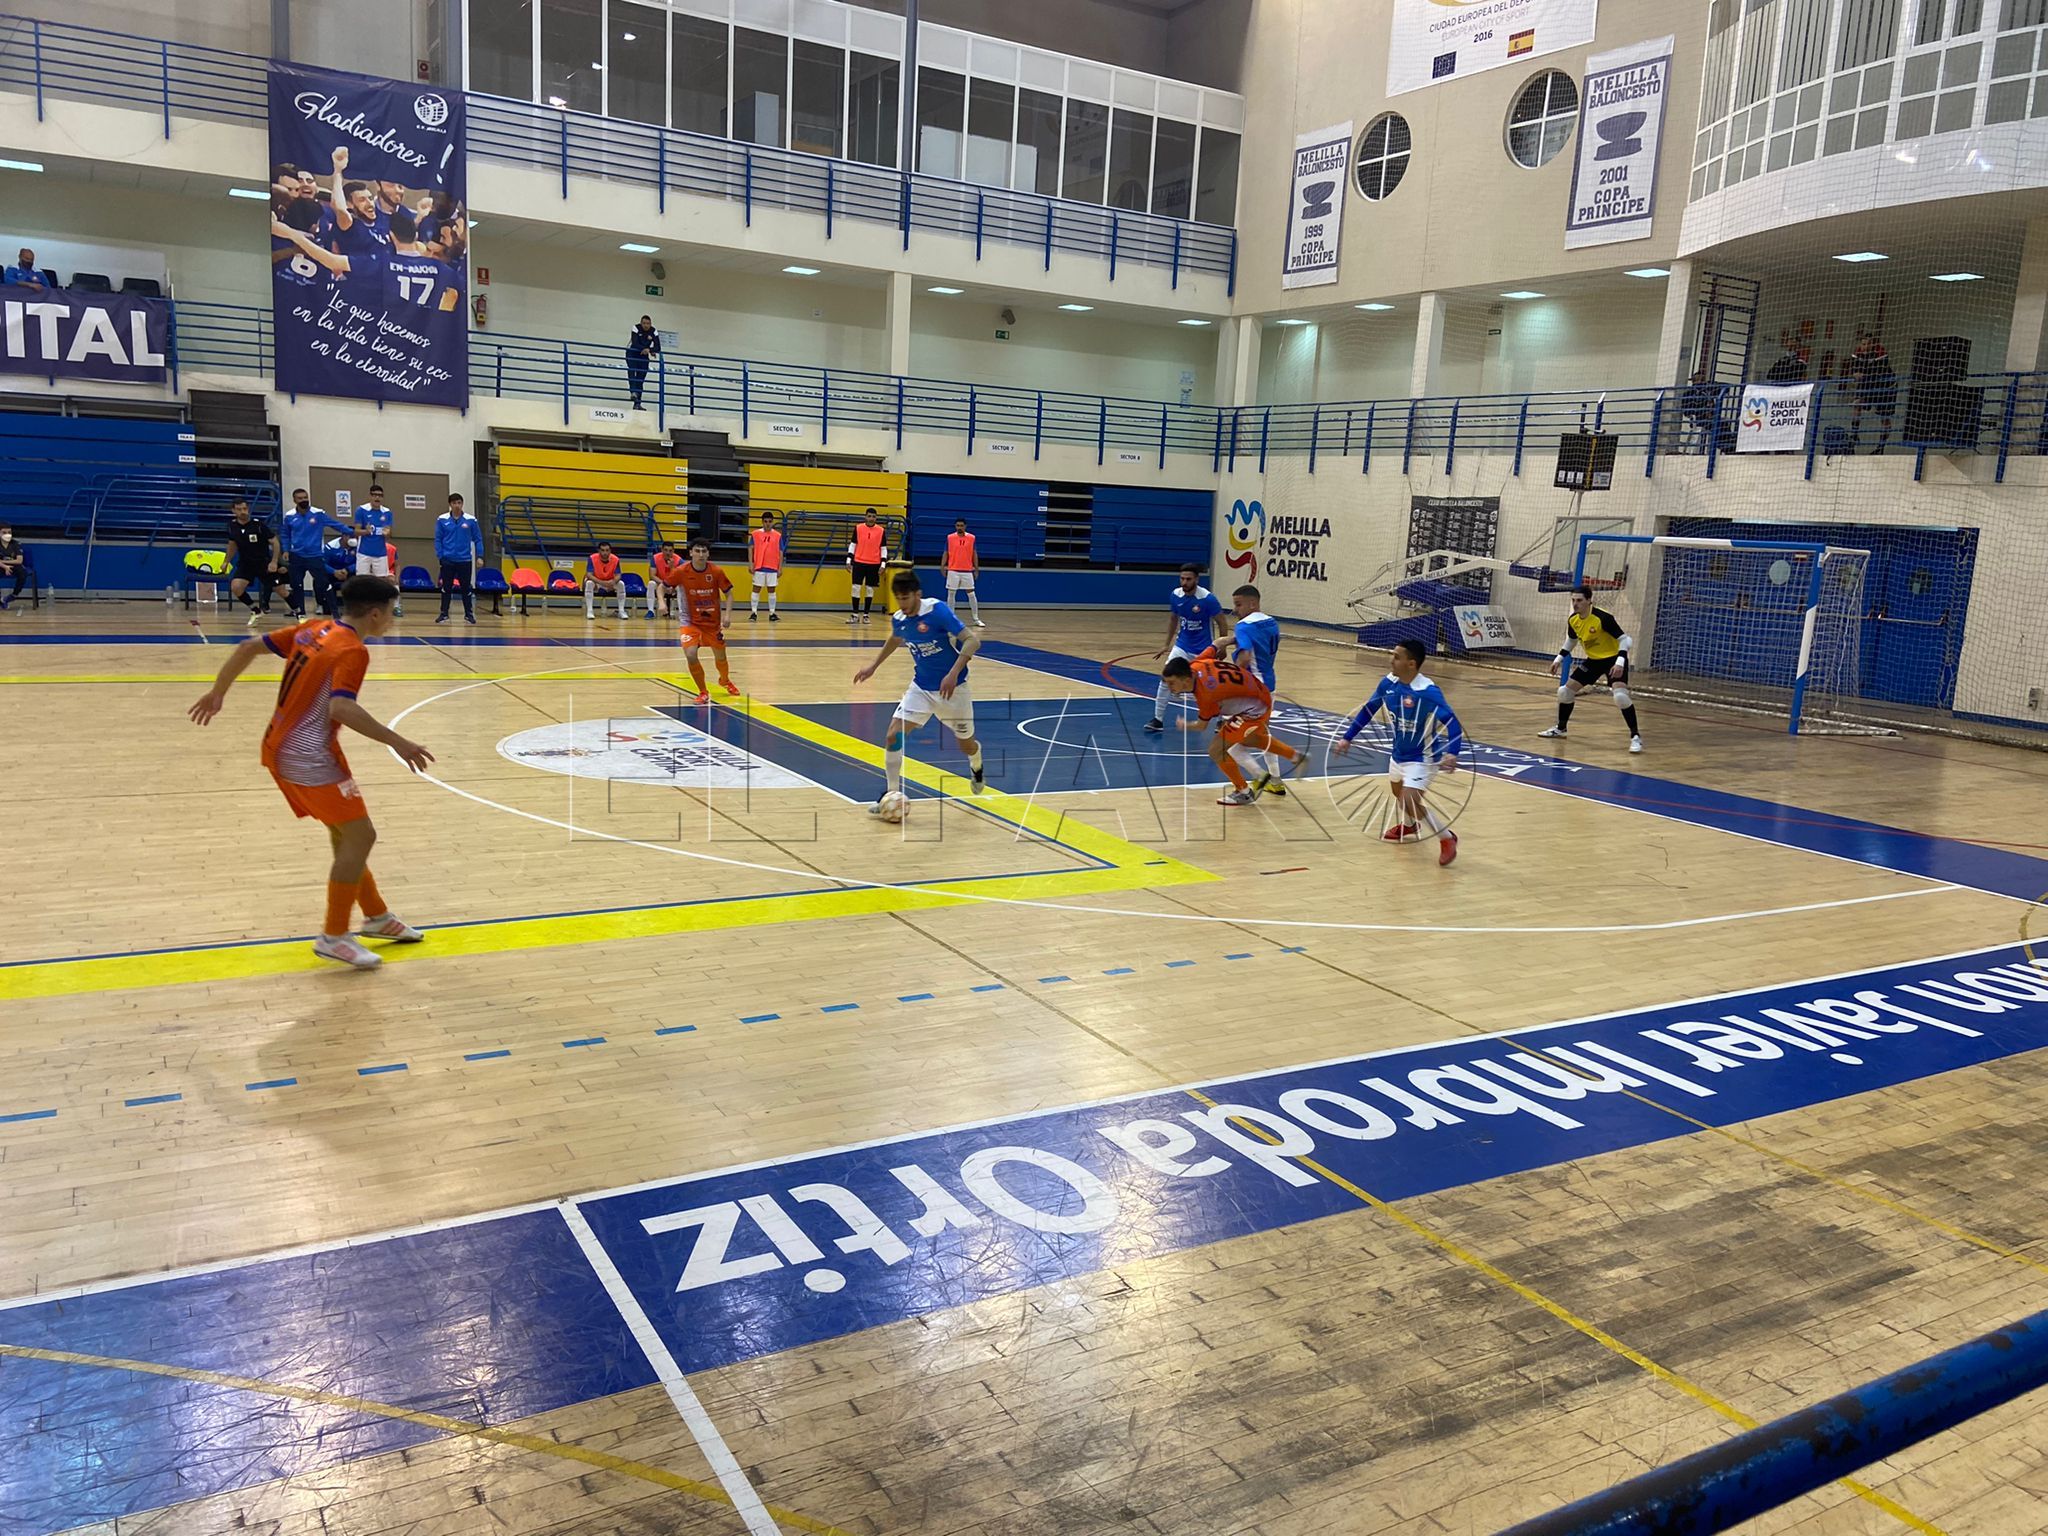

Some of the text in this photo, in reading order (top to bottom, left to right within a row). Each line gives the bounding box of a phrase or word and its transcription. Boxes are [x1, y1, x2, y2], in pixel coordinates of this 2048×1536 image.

[1429, 17, 1457, 33] CIUDAD
[1458, 6, 1492, 24] EUROPEA
[1473, 29, 1493, 43] 2016
[1593, 64, 1659, 94] MELILLA
[1588, 79, 1661, 110] BALONCESTO
[294, 91, 428, 168] Gladiadores
[1300, 144, 1343, 165] MELILLA
[1297, 156, 1345, 178] BALONCESTO
[1599, 165, 1629, 185] 2001
[1594, 185, 1630, 205] COPA
[1578, 198, 1645, 222] PRINCIPE
[1304, 223, 1324, 239] 1999
[1301, 239, 1325, 255] COPA
[1290, 250, 1335, 268] PRINCIPE
[397, 275, 435, 306] 17
[349, 304, 375, 325] que
[376, 311, 431, 348] hacemos
[292, 305, 453, 381] en la vida tiene su eco
[310, 339, 332, 356] en
[335, 342, 353, 364] la
[594, 410, 619, 419] SECTOR
[1770, 408, 1800, 418] SPORT
[1771, 400, 1807, 409] MELILLA
[773, 425, 794, 433] SECTOR
[1769, 418, 1805, 427] CAPITAL
[992, 444, 1010, 452] SECTOR
[1120, 453, 1136, 461] SECTOR
[1270, 515, 1332, 538] MELILLA
[1268, 537, 1320, 559] SPORT
[1266, 558, 1328, 581] CAPITAL
[1483, 615, 1507, 623] MELILLA
[1486, 623, 1506, 631] SPORT
[1489, 631, 1513, 639] CAPITAL
[1638, 990, 1985, 1073] Javier
[1097, 1040, 1717, 1188] Imbroda
[639, 1145, 1120, 1294] Ortiz
